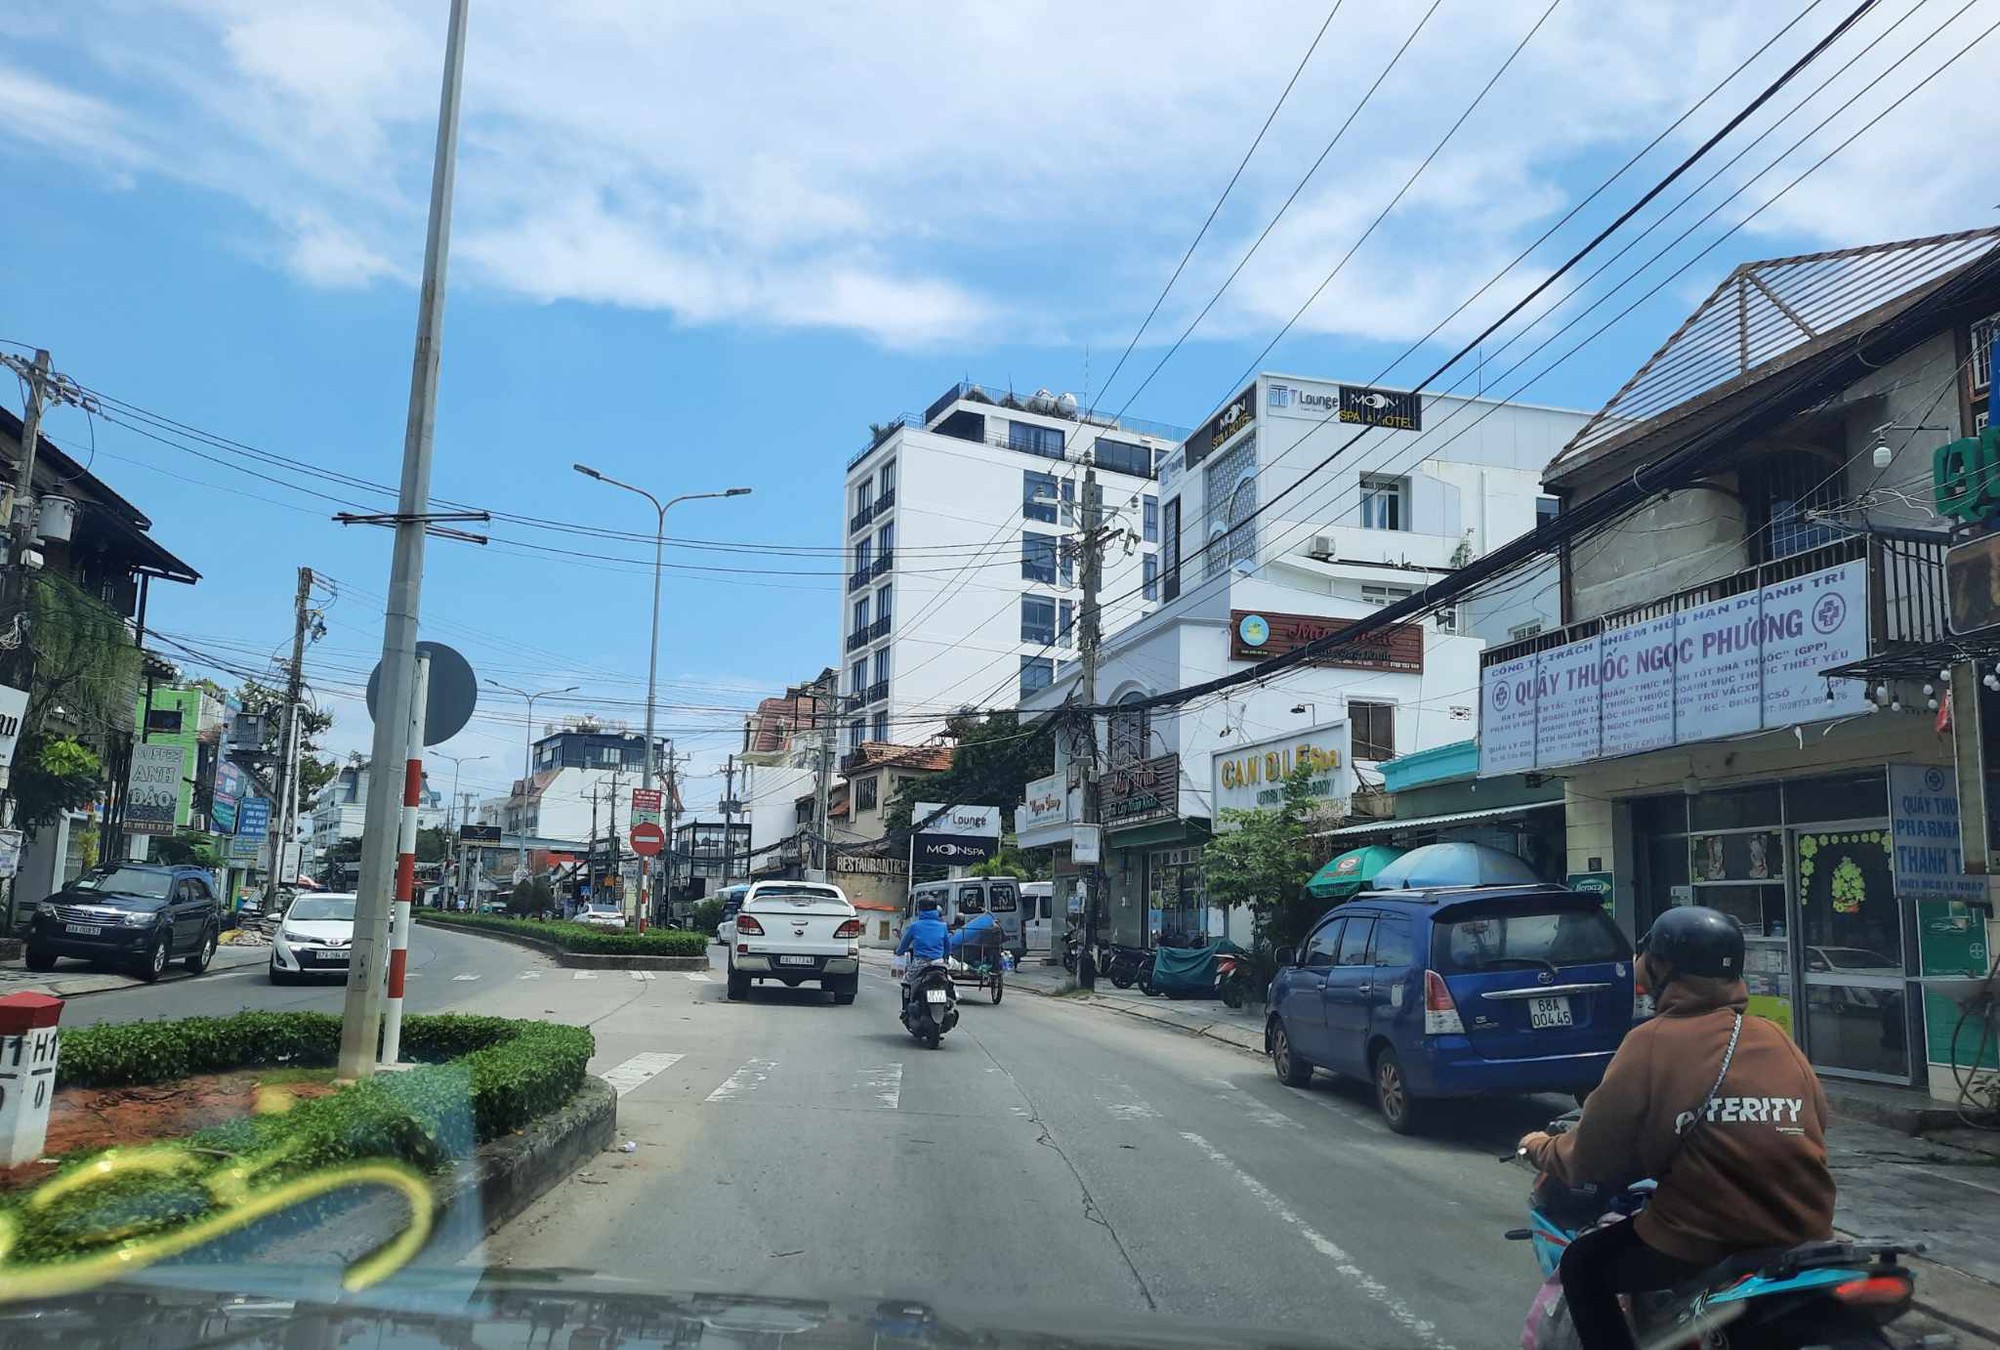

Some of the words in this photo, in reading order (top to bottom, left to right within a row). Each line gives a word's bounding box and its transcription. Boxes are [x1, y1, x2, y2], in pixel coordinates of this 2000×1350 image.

[1299, 391, 1339, 410] Lounge
[1340, 410, 1361, 422] SPA
[1515, 665, 1561, 706] QUẦY
[1566, 646, 1630, 692] THUỐC
[1637, 636, 1694, 675] NGỌC
[133, 764, 176, 784] ANH
[952, 813, 987, 828] Lounge
[1896, 819, 1960, 838] PHARMA
[1897, 846, 1948, 874] THANH
[1538, 999, 1560, 1013] 68A
[33, 1033, 58, 1063] H1
[34, 1080, 45, 1110] 0
[1674, 1097, 1803, 1135] OTERITY
